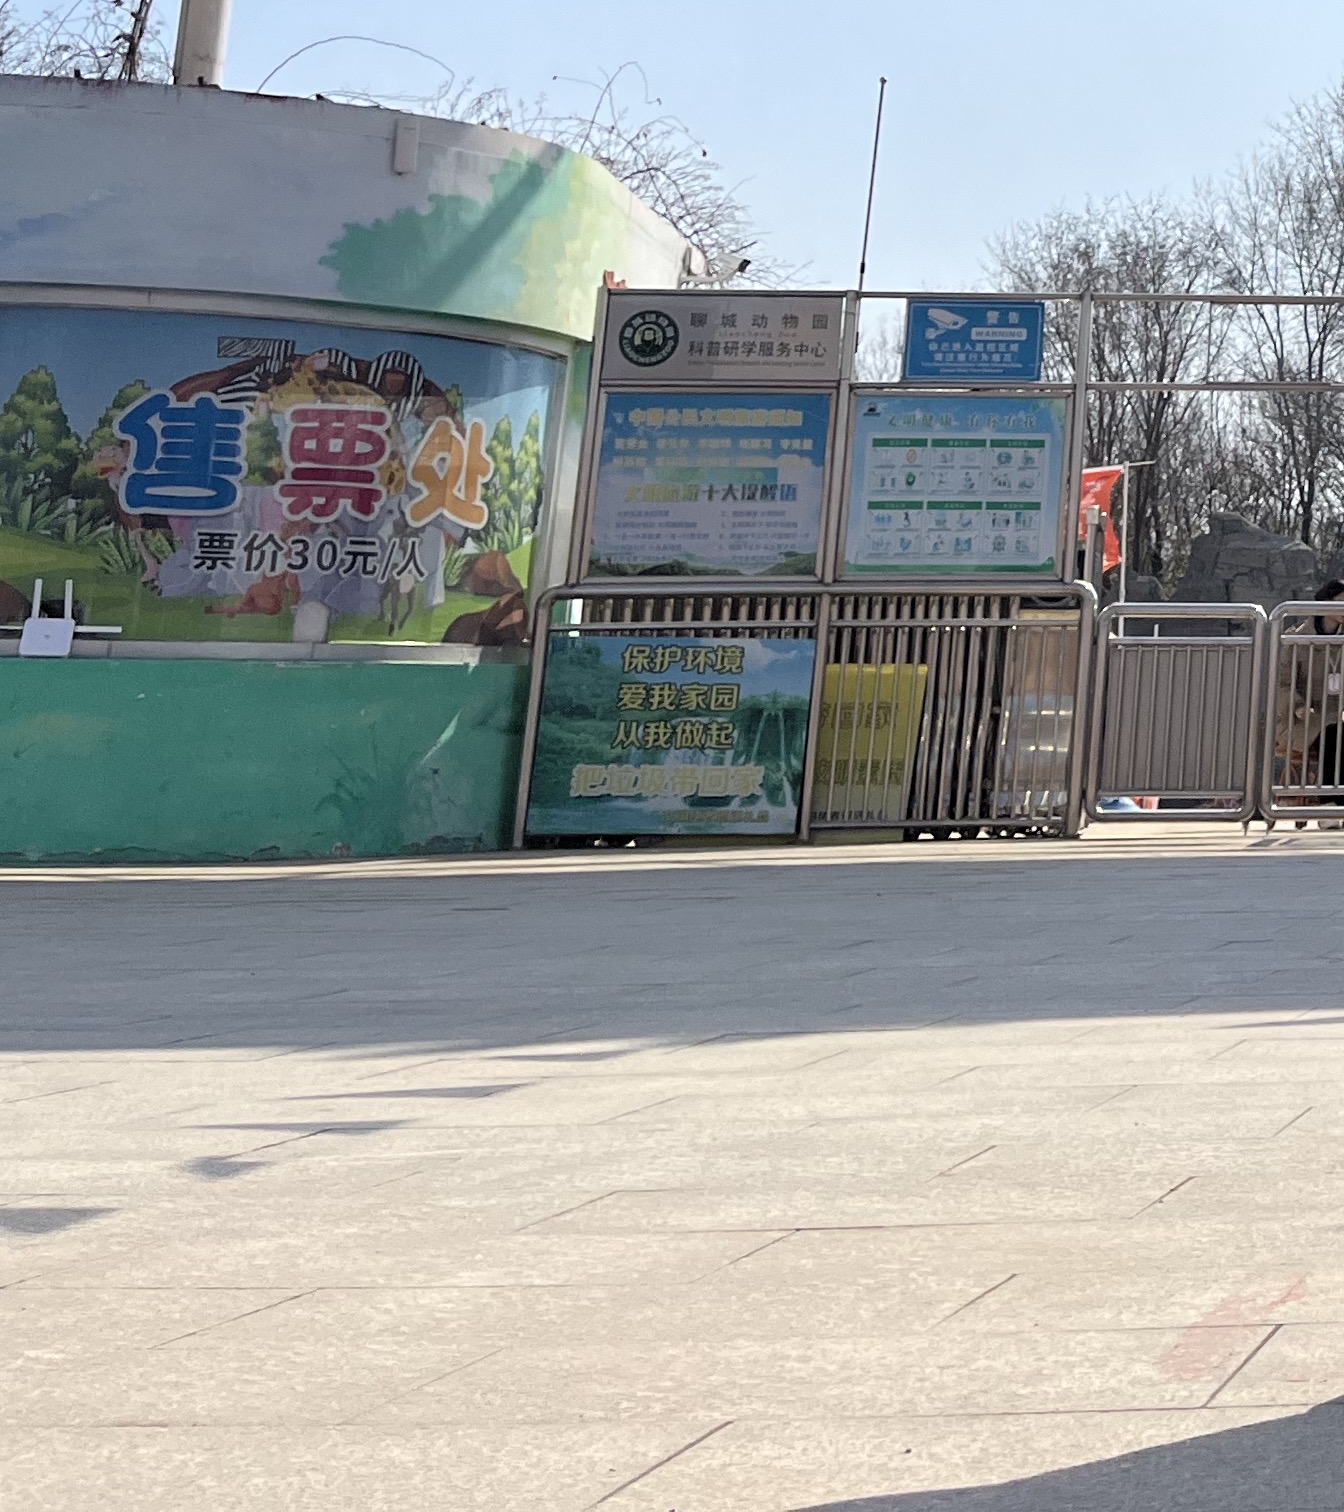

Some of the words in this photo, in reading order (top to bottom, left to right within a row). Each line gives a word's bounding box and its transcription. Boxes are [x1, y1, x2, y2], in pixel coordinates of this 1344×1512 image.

[690, 312, 829, 330] 聊城动物园
[974, 330, 1023, 338] WARNING
[688, 340, 827, 358] 科普研学服务中心
[119, 392, 493, 528] 售票处
[192, 530, 427, 580] 票价30元/人
[623, 645, 745, 673] 保护环境
[617, 683, 740, 711] 爱我家园
[611, 721, 735, 749] 从我做起
[571, 765, 764, 797] 把垃圾带回家
